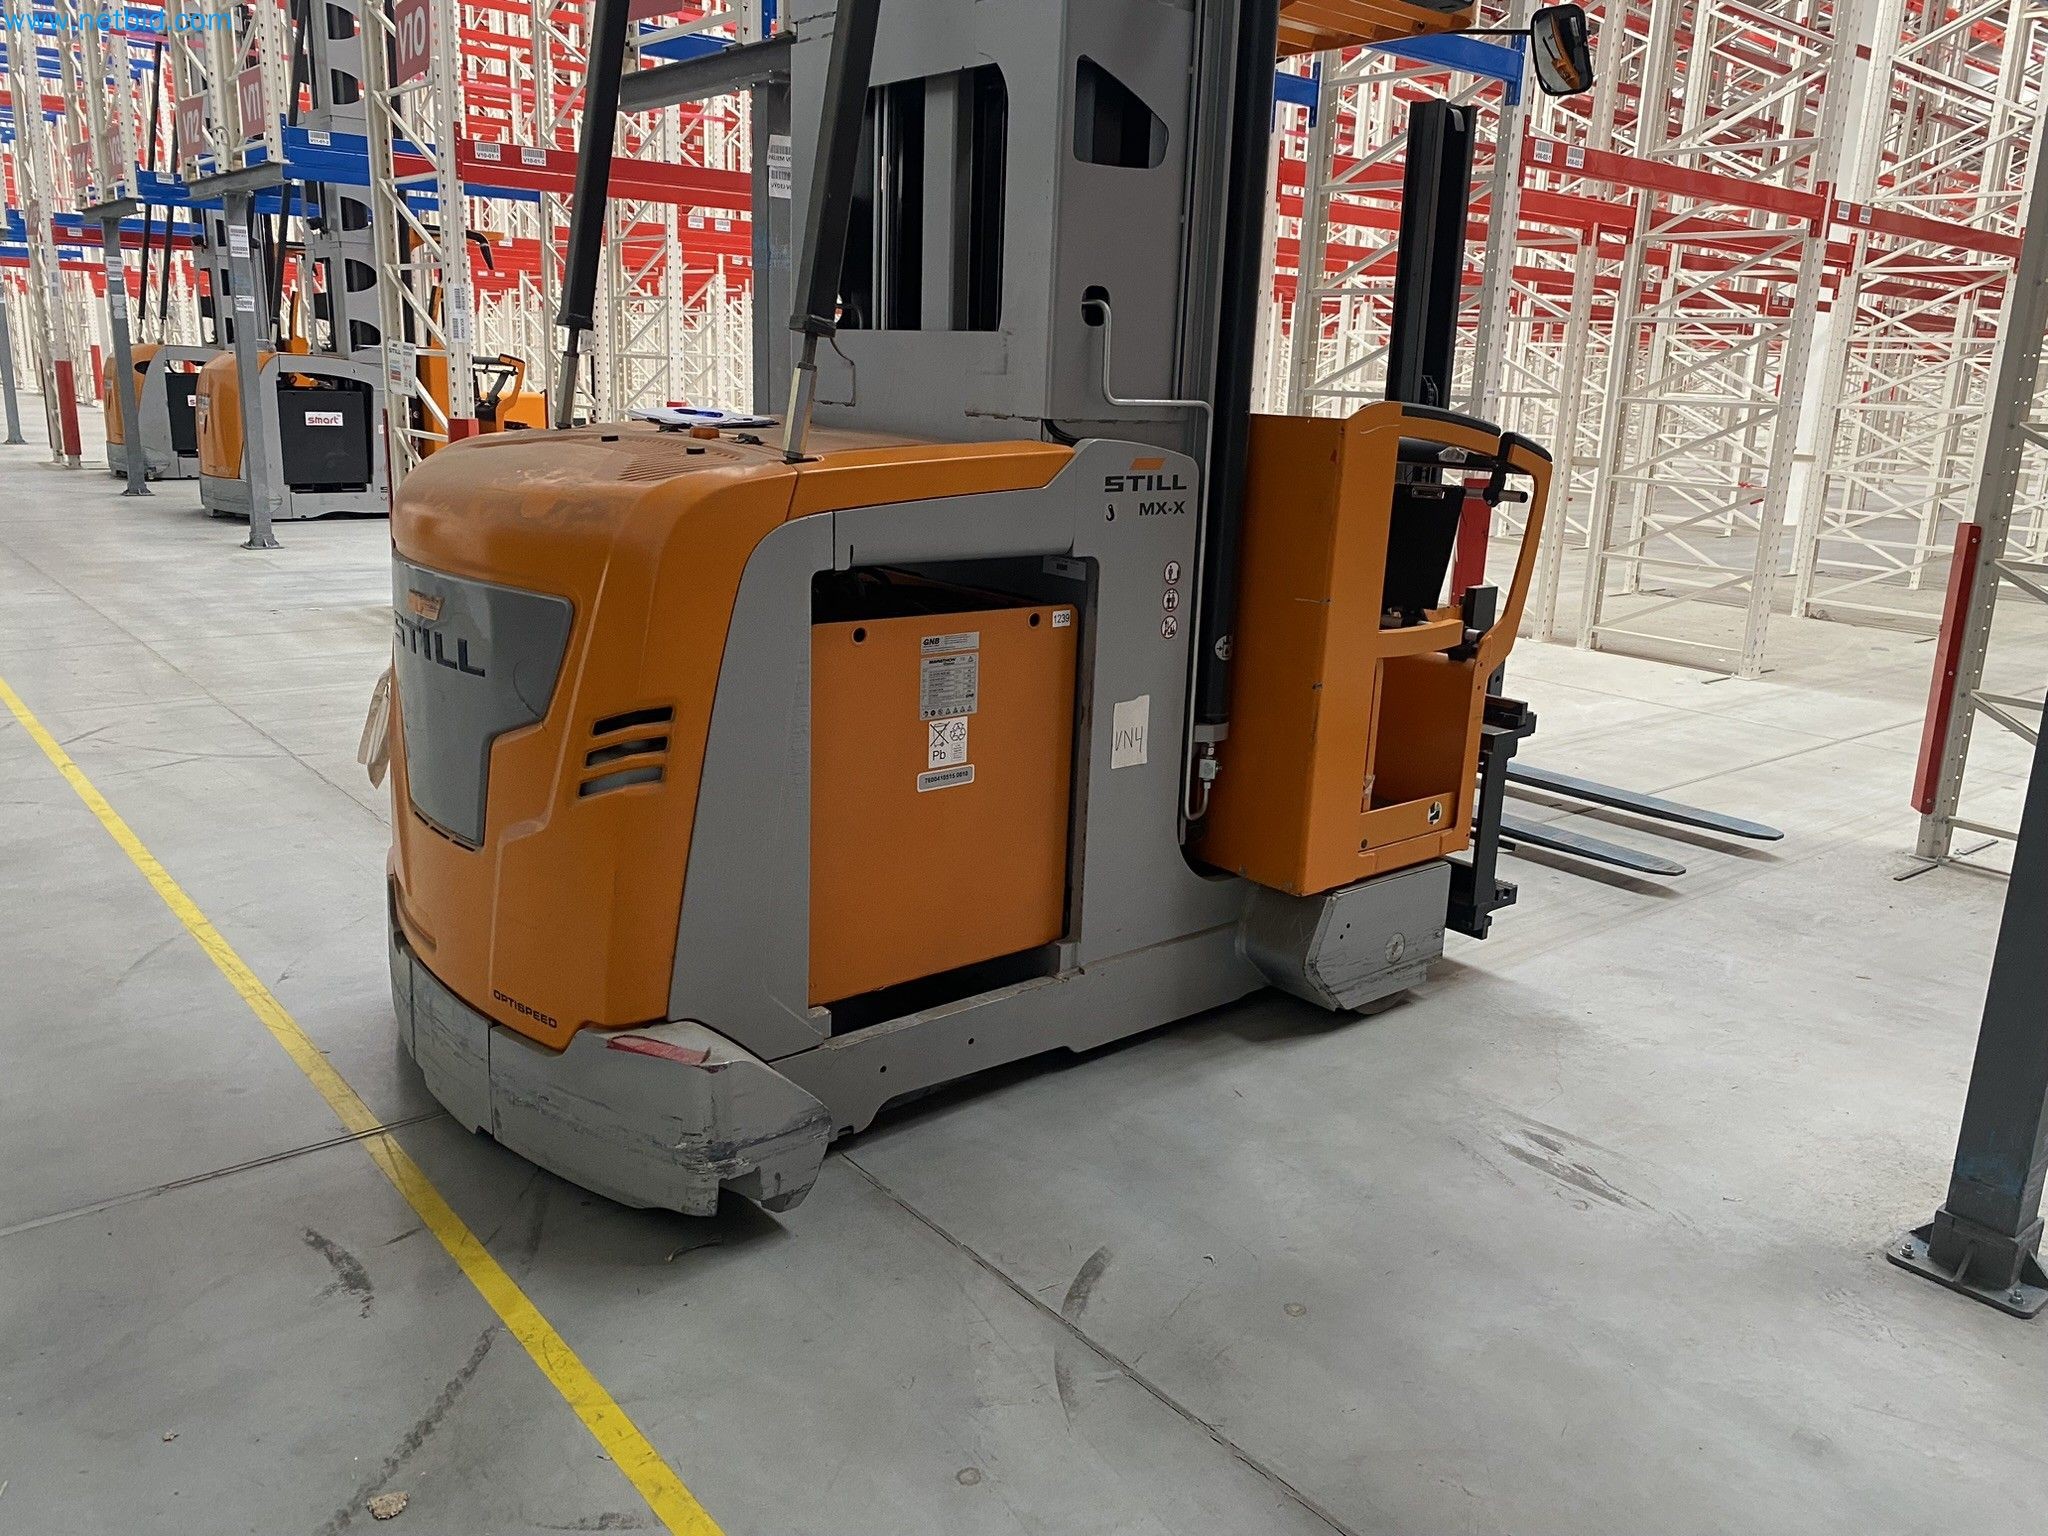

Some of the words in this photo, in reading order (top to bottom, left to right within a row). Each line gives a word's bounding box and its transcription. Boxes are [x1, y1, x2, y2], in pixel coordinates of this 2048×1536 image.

[398, 6, 426, 65] V10
[243, 82, 262, 122] V11
[183, 108, 200, 145] V12
[307, 415, 339, 424] smart
[1104, 474, 1187, 493] STILL
[1053, 613, 1070, 624] 1239
[394, 610, 486, 678] STILL
[922, 637, 940, 646] GNB
[1115, 725, 1143, 753] VN4
[932, 750, 947, 761] Pb
[493, 989, 558, 1029] OPTISPEED
